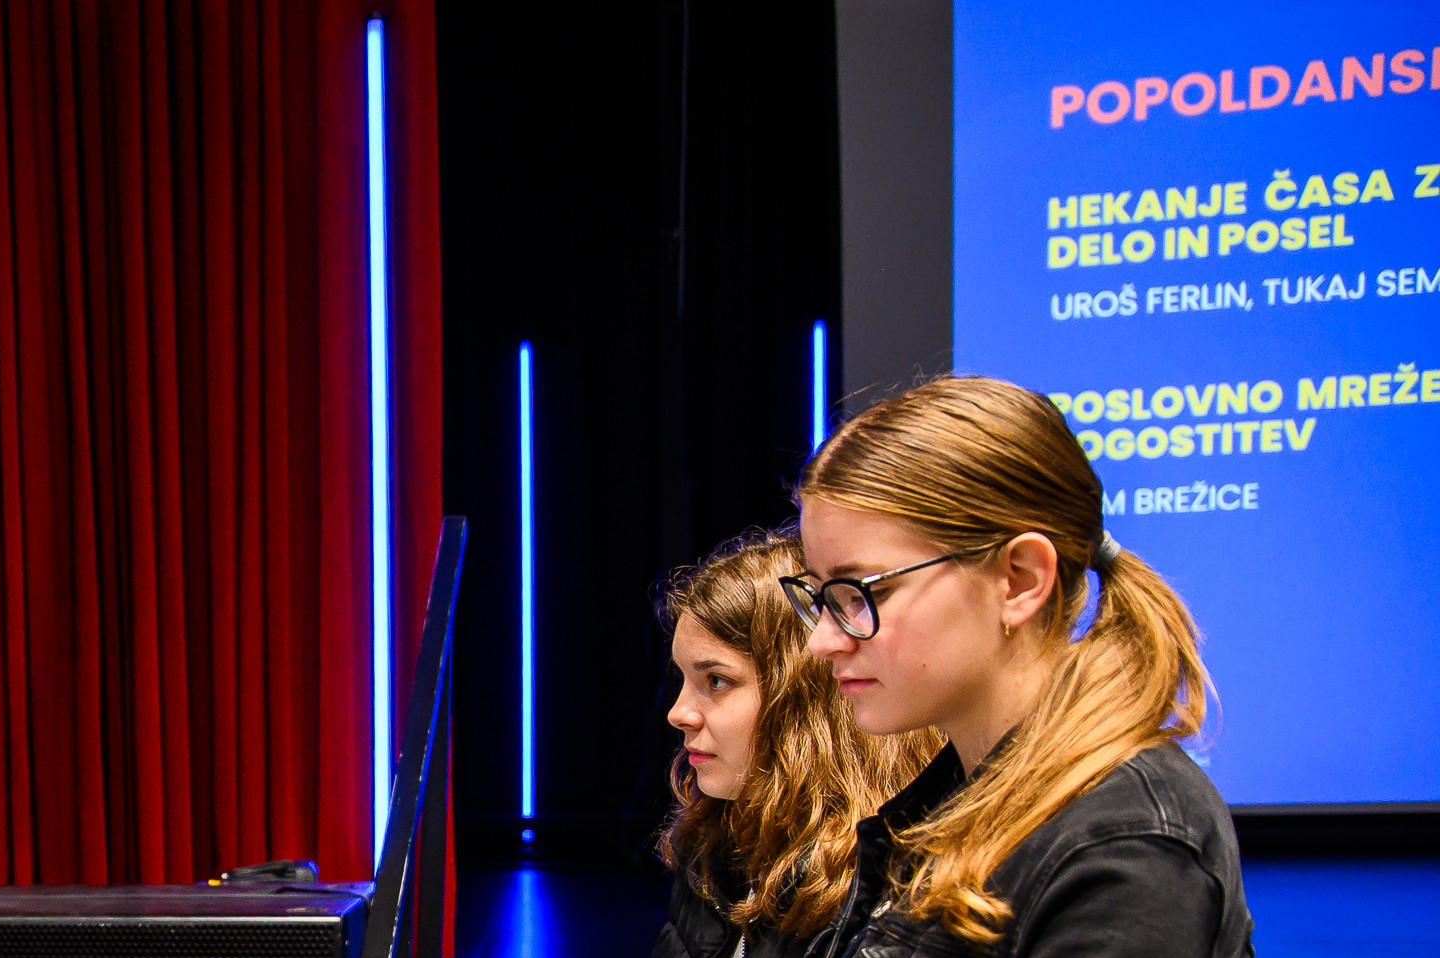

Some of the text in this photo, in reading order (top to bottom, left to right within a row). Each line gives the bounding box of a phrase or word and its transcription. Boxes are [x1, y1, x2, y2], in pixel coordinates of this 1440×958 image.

[1049, 46, 1440, 129] POPOLDANS
[1047, 182, 1248, 229] HEKANJE
[1264, 168, 1395, 211] ČASA
[1047, 214, 1355, 269] DELO IN POSEL
[1051, 266, 1440, 321] UROŠ FERLIN, TUKAJ SEM
[1048, 362, 1440, 424] POSLOVNO MREŽE
[1133, 480, 1259, 515] BREŽICE
